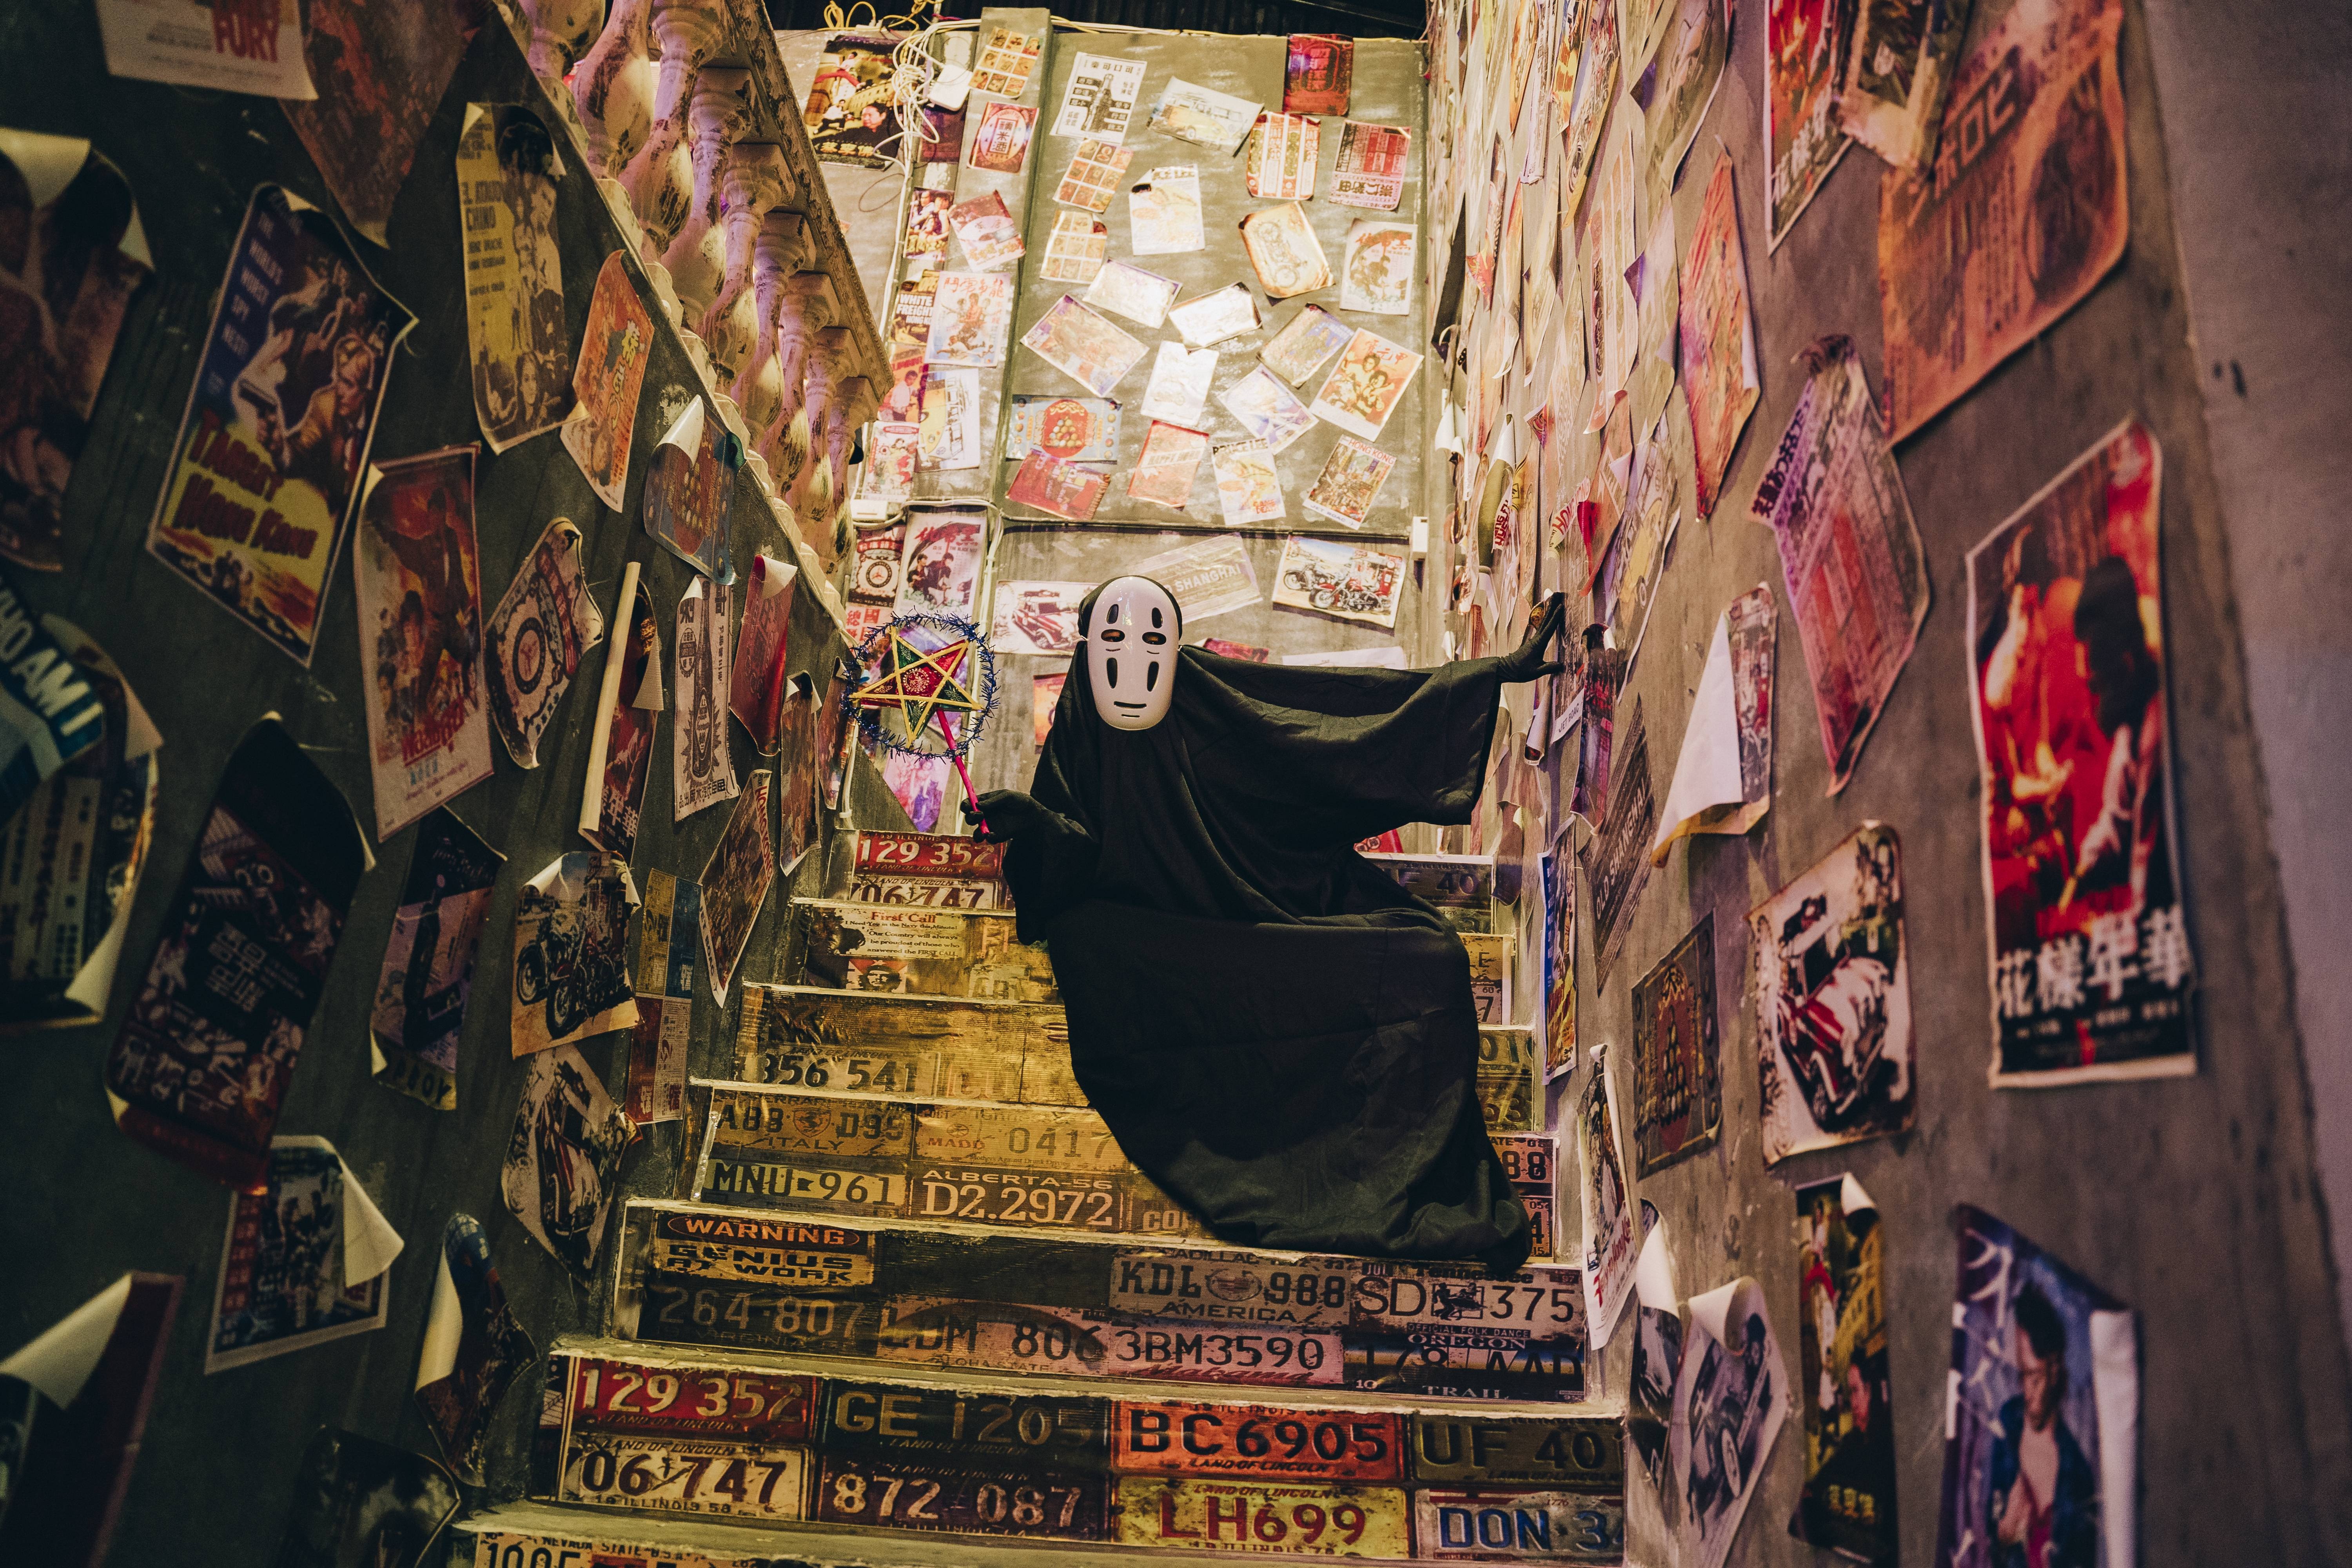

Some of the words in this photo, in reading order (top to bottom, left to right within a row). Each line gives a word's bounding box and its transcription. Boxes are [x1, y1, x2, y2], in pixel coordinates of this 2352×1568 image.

[900, 294, 933, 306] WHITE
[188, 408, 285, 503] TARGET
[1348, 437, 1372, 454] HONG
[1372, 447, 1396, 465] KONG
[172, 473, 256, 544] HONG
[250, 509, 319, 559] KONG
[1176, 563, 1241, 593] SHANGHAI
[10, 648, 91, 719] AM
[60, 702, 104, 737] I
[1558, 718, 1569, 733] JET
[1568, 702, 1580, 724] BOAC
[860, 839, 920, 864] 129
[929, 843, 995, 867] 352
[1595, 874, 1610, 920] OLD
[1609, 776, 1647, 883] SHANGHAI
[919, 886, 985, 909] 747
[871, 911, 902, 921] First
[908, 913, 936, 924] Call
[884, 931, 915, 940] Country
[846, 1059, 918, 1093] 541
[768, 1137, 845, 1151] ITALY
[927, 1137, 984, 1150] MADD
[1008, 1127, 1113, 1159] 0417
[998, 1157, 1022, 1165] Against
[713, 1161, 793, 1197] MNU
[818, 1171, 895, 1207] 961
[922, 1169, 1112, 1190] ALBERTA-56
[920, 1180, 1113, 1227] D2.2972
[685, 1218, 845, 1246] WARNING
[668, 1244, 853, 1270] GENIUS
[733, 1263, 851, 1283] WORK
[1366, 1264, 1388, 1275] JUL
[1119, 1260, 1203, 1298] KDL
[1269, 1271, 1346, 1308] 988
[1355, 1276, 1427, 1317] SD
[1490, 1285, 1574, 1322] 375
[1161, 1301, 1297, 1323] AMERICA
[1012, 1319, 1103, 1363] 806
[1408, 1323, 1455, 1334] OFFICIAL
[1461, 1325, 1488, 1336] FOLK
[1493, 1328, 1529, 1338] DANCE
[1115, 1330, 1324, 1370] 3BM3590
[1407, 1334, 1526, 1350] OREGON
[1002, 1360, 1049, 1372] STATE
[1140, 1364, 1314, 1381] Alabama
[581, 1368, 680, 1414] 129
[696, 1376, 802, 1422] 352
[1355, 1379, 1376, 1390] 10
[1422, 1385, 1501, 1399] TRAIL
[834, 1390, 923, 1438] GE
[952, 1400, 1094, 1447] 1205
[1218, 1405, 1298, 1415] ILLINOIS
[604, 1414, 644, 1427] LAND
[674, 1418, 742, 1431] LINCOLN
[602, 1439, 644, 1451] LAND
[646, 1440, 667, 1452] OF
[670, 1442, 737, 1457] LINCOLN
[889, 1437, 933, 1450] LAND
[962, 1441, 1027, 1456] LINCOLN
[1421, 1423, 1510, 1469] UF
[1189, 1458, 1233, 1469] LAND
[1235, 1460, 1258, 1470] OF
[1259, 1461, 1330, 1473] LINCOLN
[680, 1456, 787, 1512] 747
[1193, 1484, 1236, 1495] LAND
[1263, 1486, 1332, 1498] LINCOLN
[621, 1496, 701, 1512] ILLINOIS
[833, 1472, 942, 1521] 872
[976, 1482, 1082, 1528] 087
[1546, 1498, 1569, 1506] 1776
[1436, 1506, 1552, 1552] DON
[1573, 1510, 1622, 1552] 3
[602, 1543, 642, 1557] STATE
